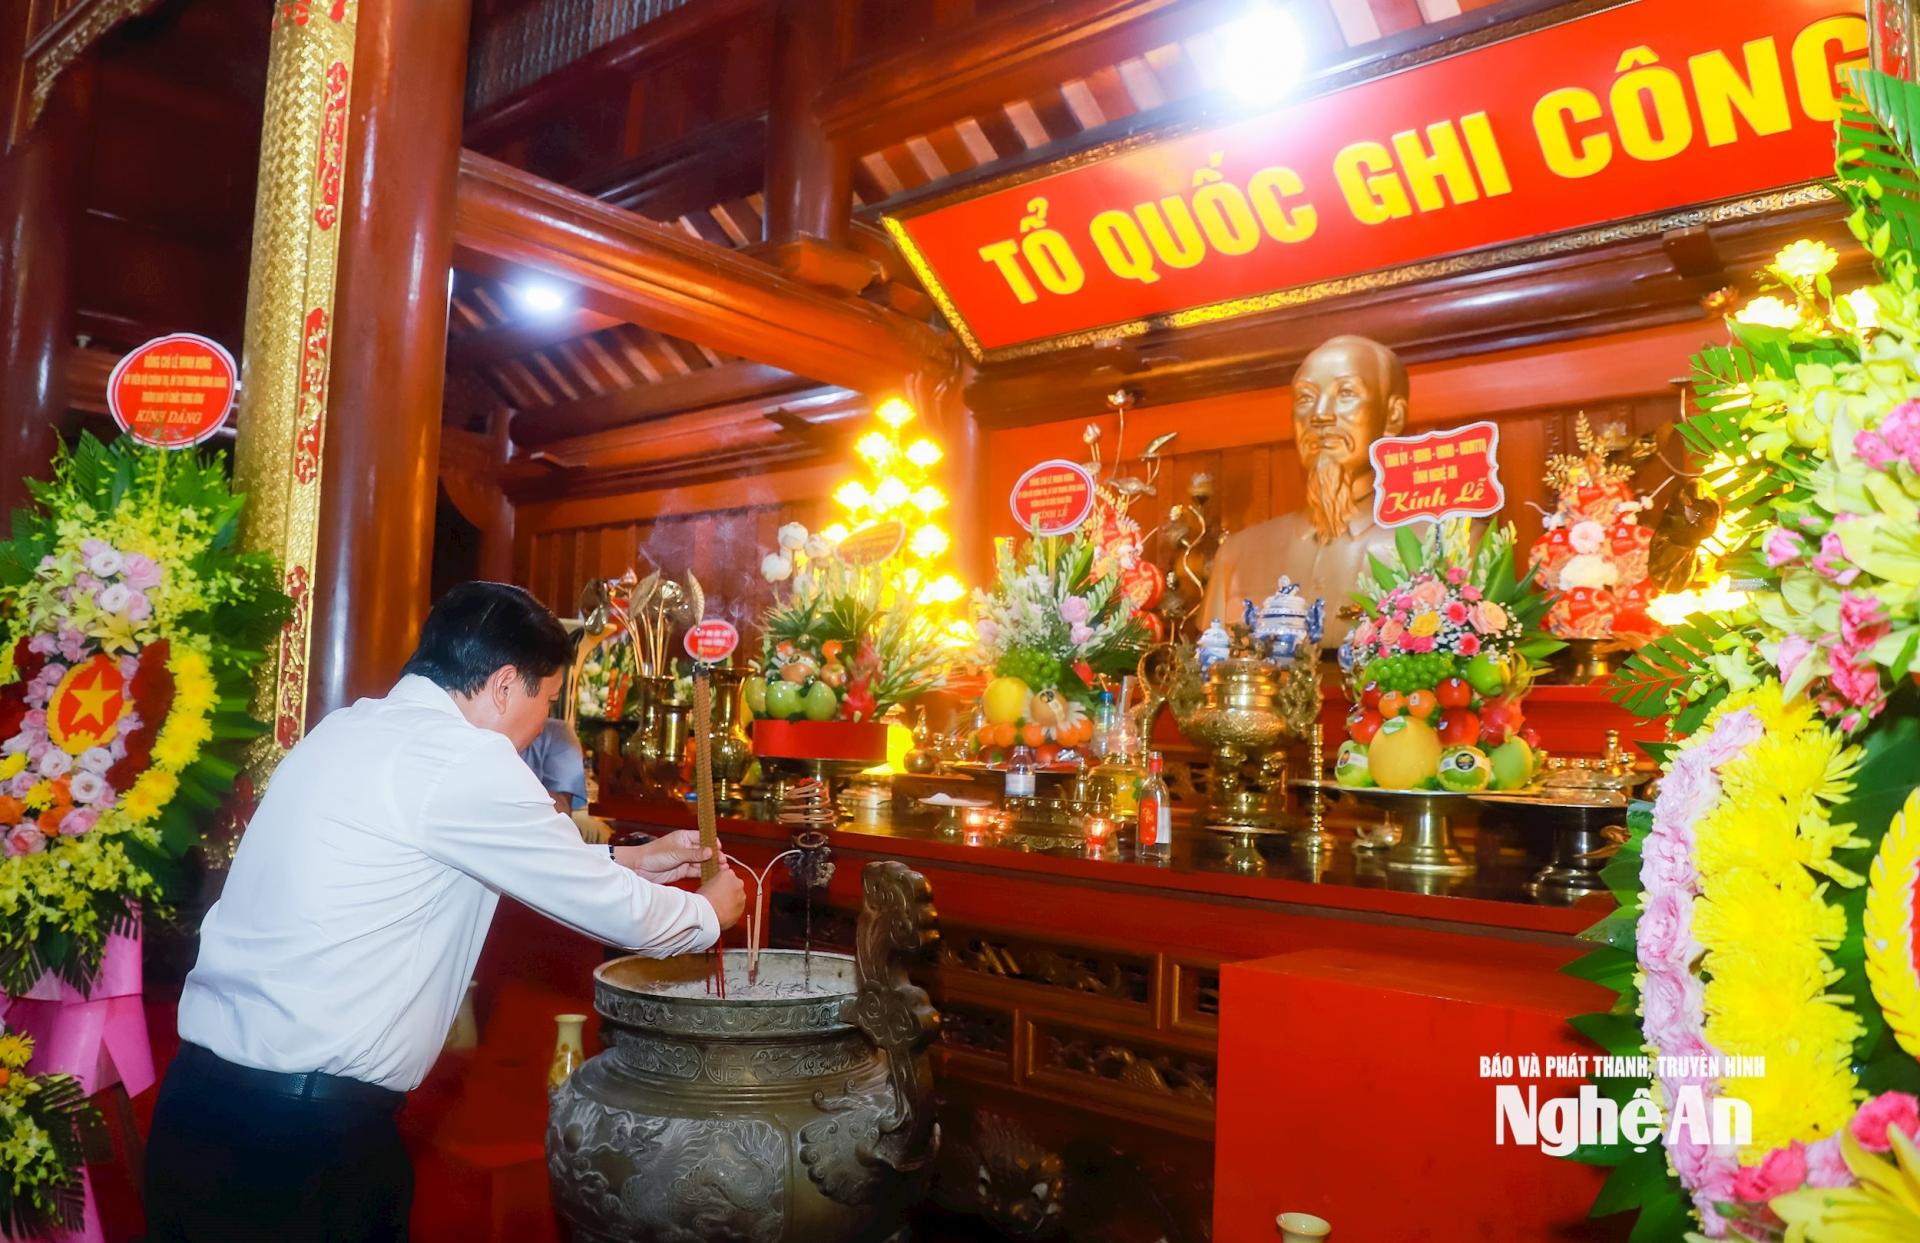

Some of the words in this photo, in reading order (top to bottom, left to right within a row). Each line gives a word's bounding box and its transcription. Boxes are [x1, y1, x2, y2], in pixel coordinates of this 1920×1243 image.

[979, 197, 1085, 306] TỔ
[1089, 150, 1319, 285] QUỐC
[1332, 110, 1513, 226] GHI
[1532, 14, 1868, 178] CÔNG
[1384, 486, 1447, 514] Kính
[1454, 478, 1488, 504] Lễ
